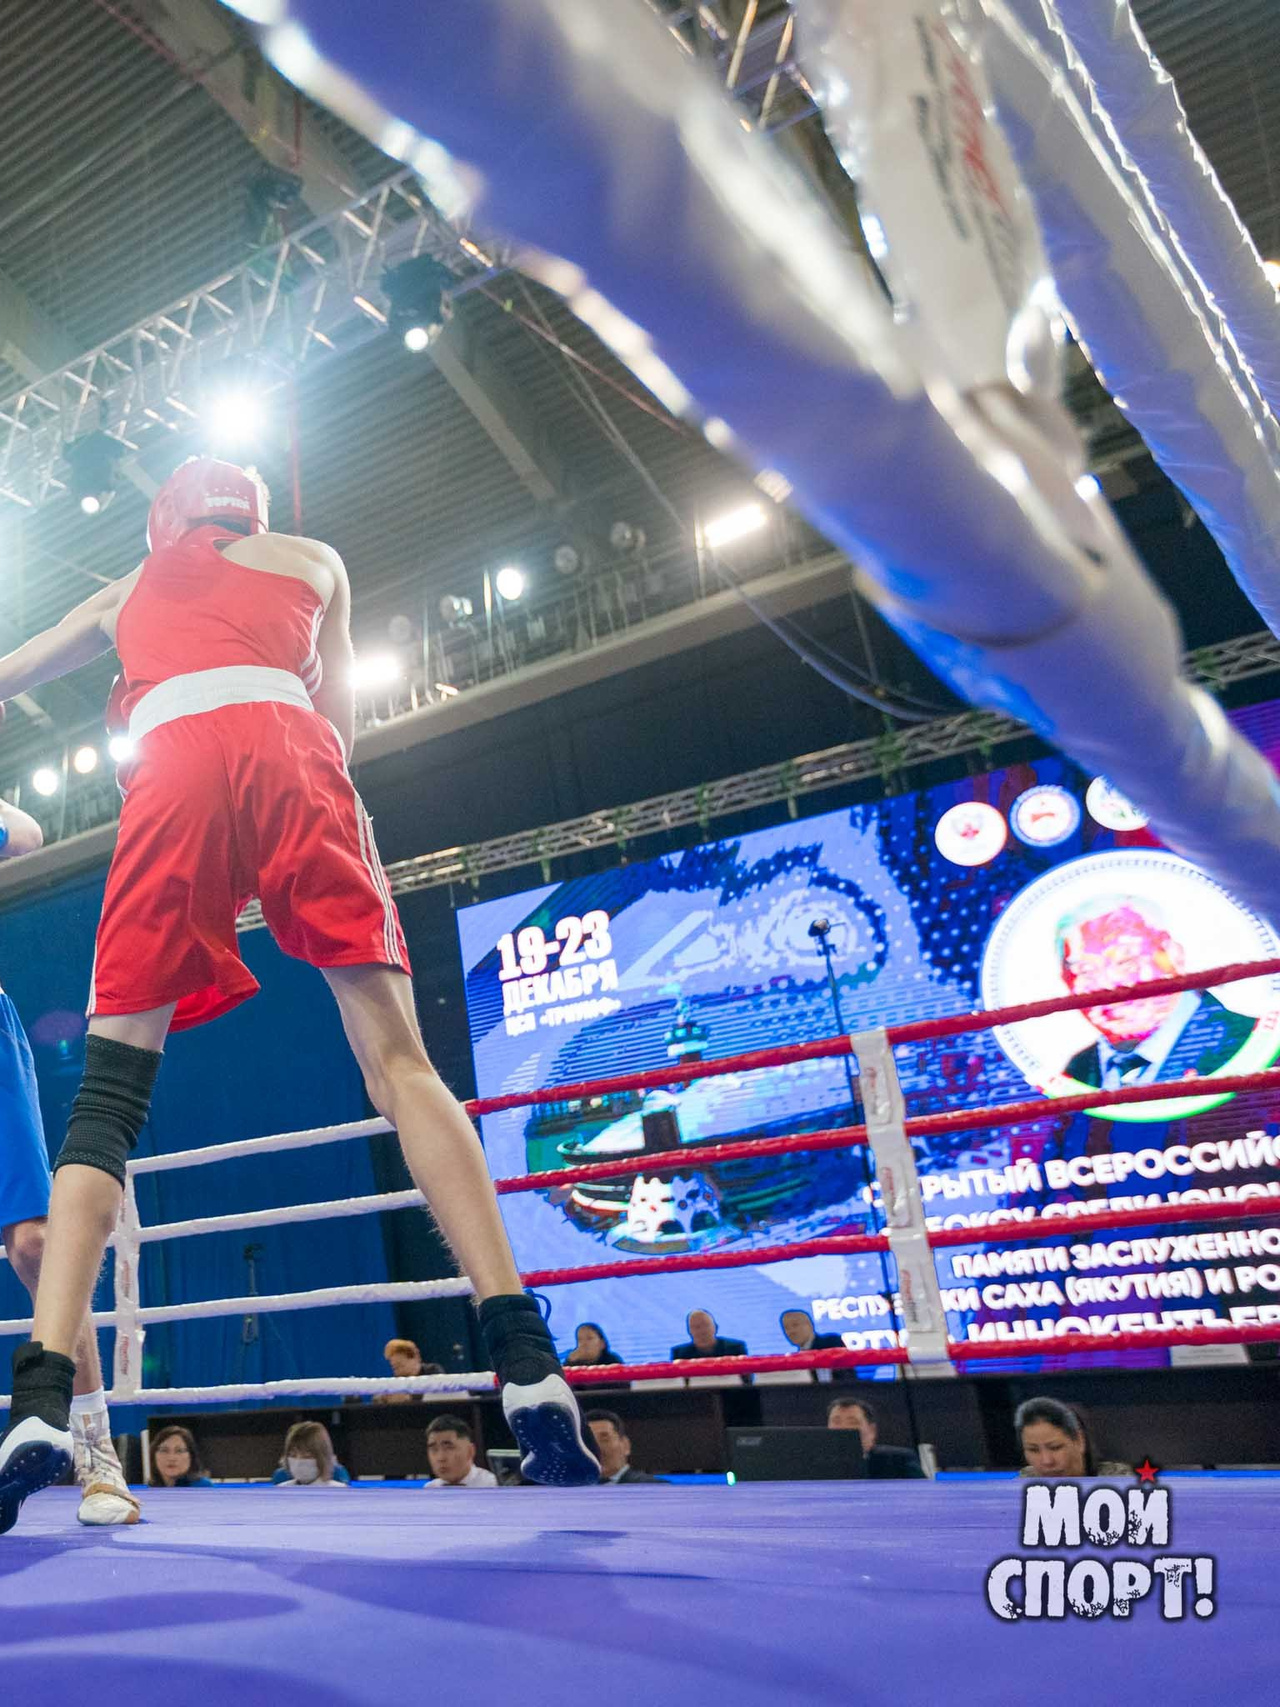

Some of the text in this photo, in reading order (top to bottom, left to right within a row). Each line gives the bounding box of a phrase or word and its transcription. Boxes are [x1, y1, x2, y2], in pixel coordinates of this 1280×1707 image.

[497, 909, 612, 982] 19-23
[502, 958, 619, 1017] ДЕКАБРЯ
[1044, 1130, 1280, 1190] ВСЕРОССИЙ
[951, 1246, 1070, 1279] ПАМЯТИ
[982, 1280, 1066, 1311] САХА
[1066, 1267, 1204, 1307] (ЯКУТИЯ)
[1204, 1267, 1235, 1295] И
